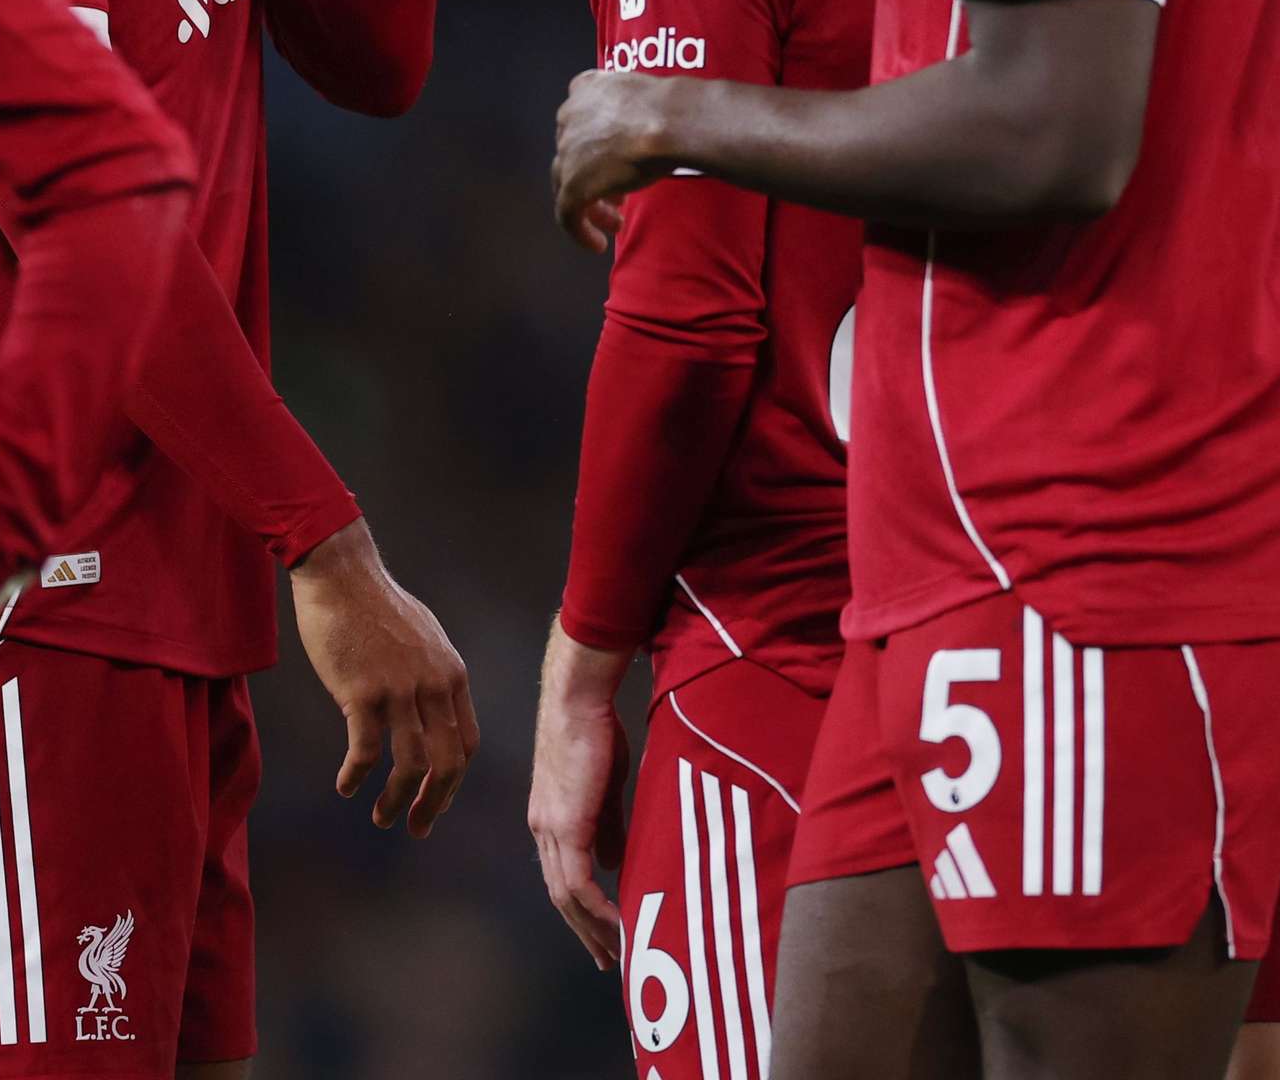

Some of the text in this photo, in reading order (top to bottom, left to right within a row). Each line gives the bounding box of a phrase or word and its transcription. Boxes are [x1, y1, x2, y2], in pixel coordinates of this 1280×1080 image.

[919, 649, 1001, 813] 5
[75, 1015, 136, 1041] L.F.C.
[628, 891, 689, 1052] 6
